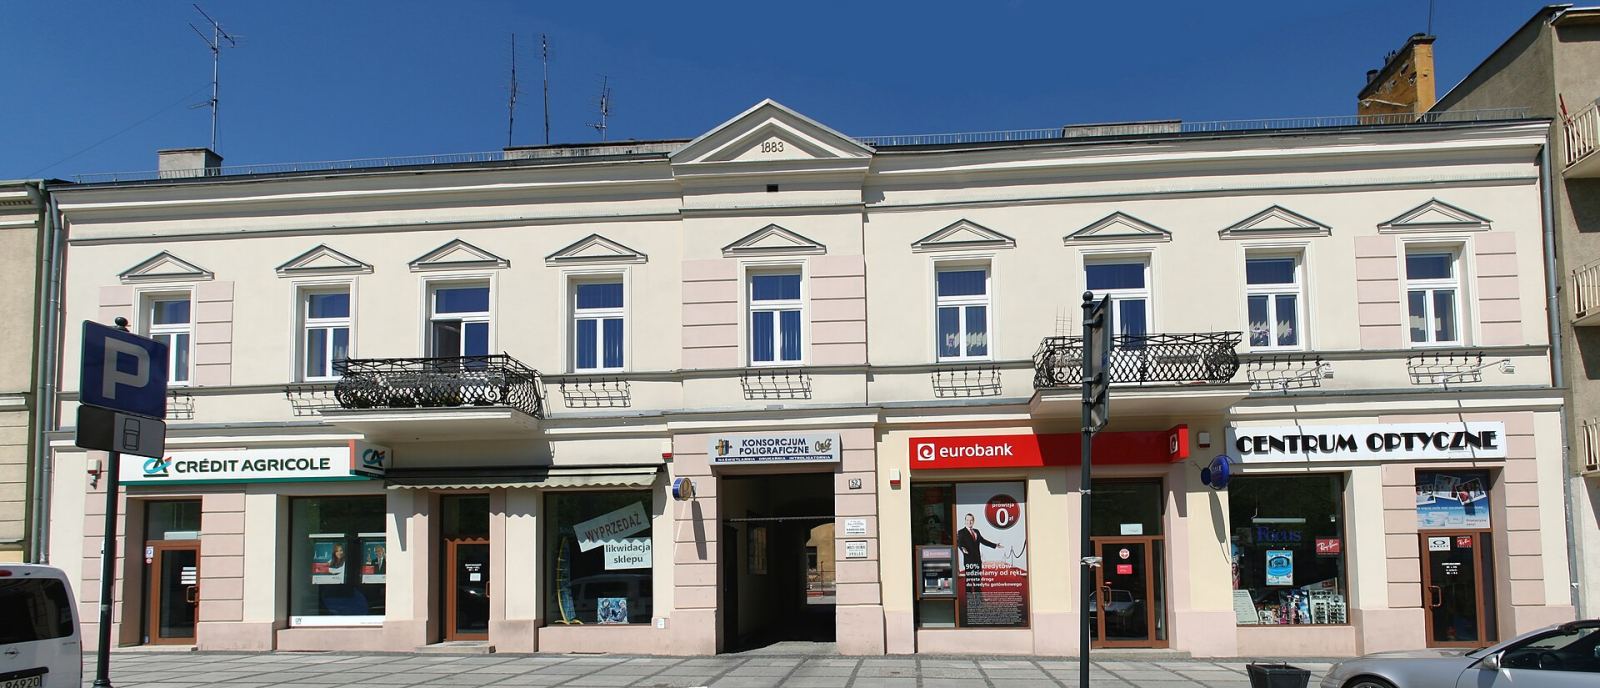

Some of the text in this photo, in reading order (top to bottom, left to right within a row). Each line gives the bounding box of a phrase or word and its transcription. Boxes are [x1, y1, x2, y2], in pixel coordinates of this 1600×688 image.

[761, 141, 784, 153] 1883
[102, 336, 151, 400] P
[742, 438, 807, 447] KONSORCJUM
[1236, 431, 1498, 455] CENTRUM OPTYCZNE
[739, 446, 810, 455] POLIGRAFICZNE
[940, 443, 1013, 458] eurobank
[175, 457, 331, 474] CRÉDIT AGRICOLE
[995, 508, 1009, 527] 0
[584, 511, 642, 543] WYPRZEDAŻ
[605, 543, 651, 553] likwidacja
[613, 555, 643, 565] sklepu
[965, 569, 998, 577] udzielamy
